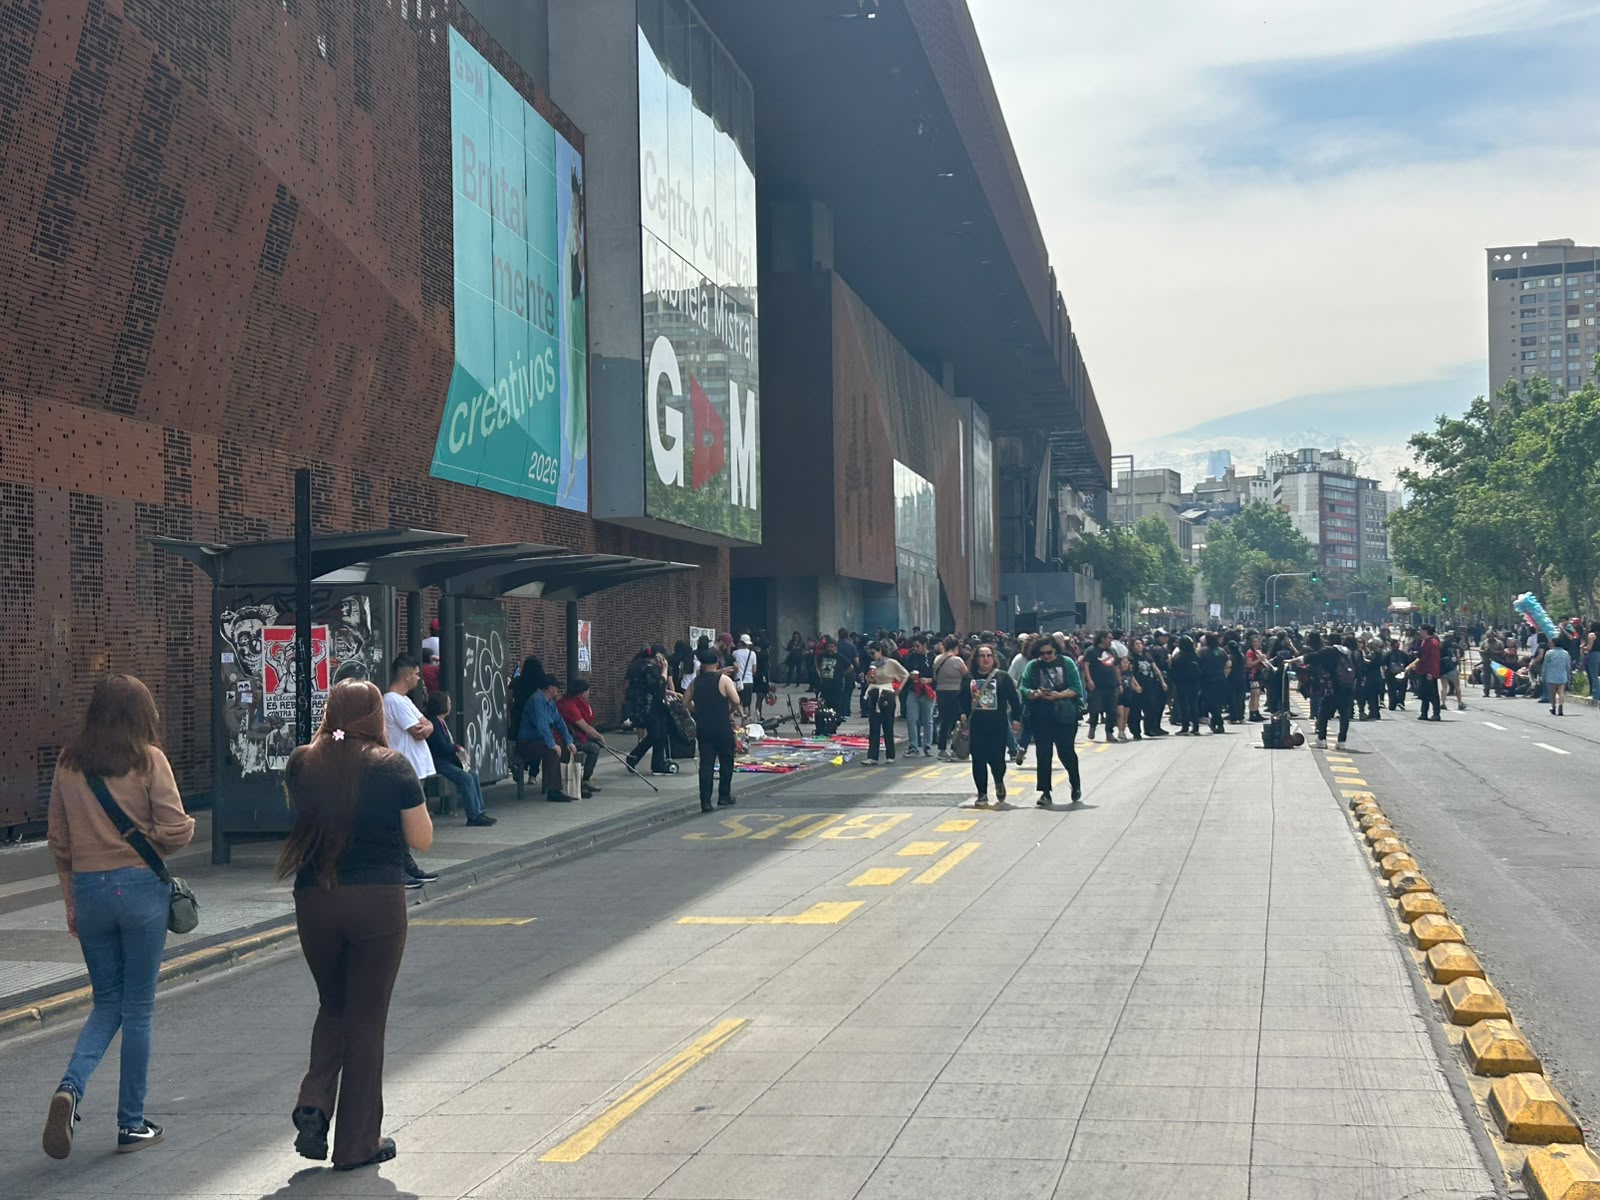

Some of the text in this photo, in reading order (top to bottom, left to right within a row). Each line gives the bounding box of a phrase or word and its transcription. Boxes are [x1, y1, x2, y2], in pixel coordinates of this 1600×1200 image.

[461, 134, 527, 236] Brutal
[643, 150, 755, 299] Centro Cultural
[493, 251, 555, 337] mente
[646, 233, 753, 361] Gabriela Mistral
[448, 346, 556, 455] creativos
[528, 451, 558, 486] 2026
[266, 702, 278, 710] ES
[681, 812, 914, 840] BUS
